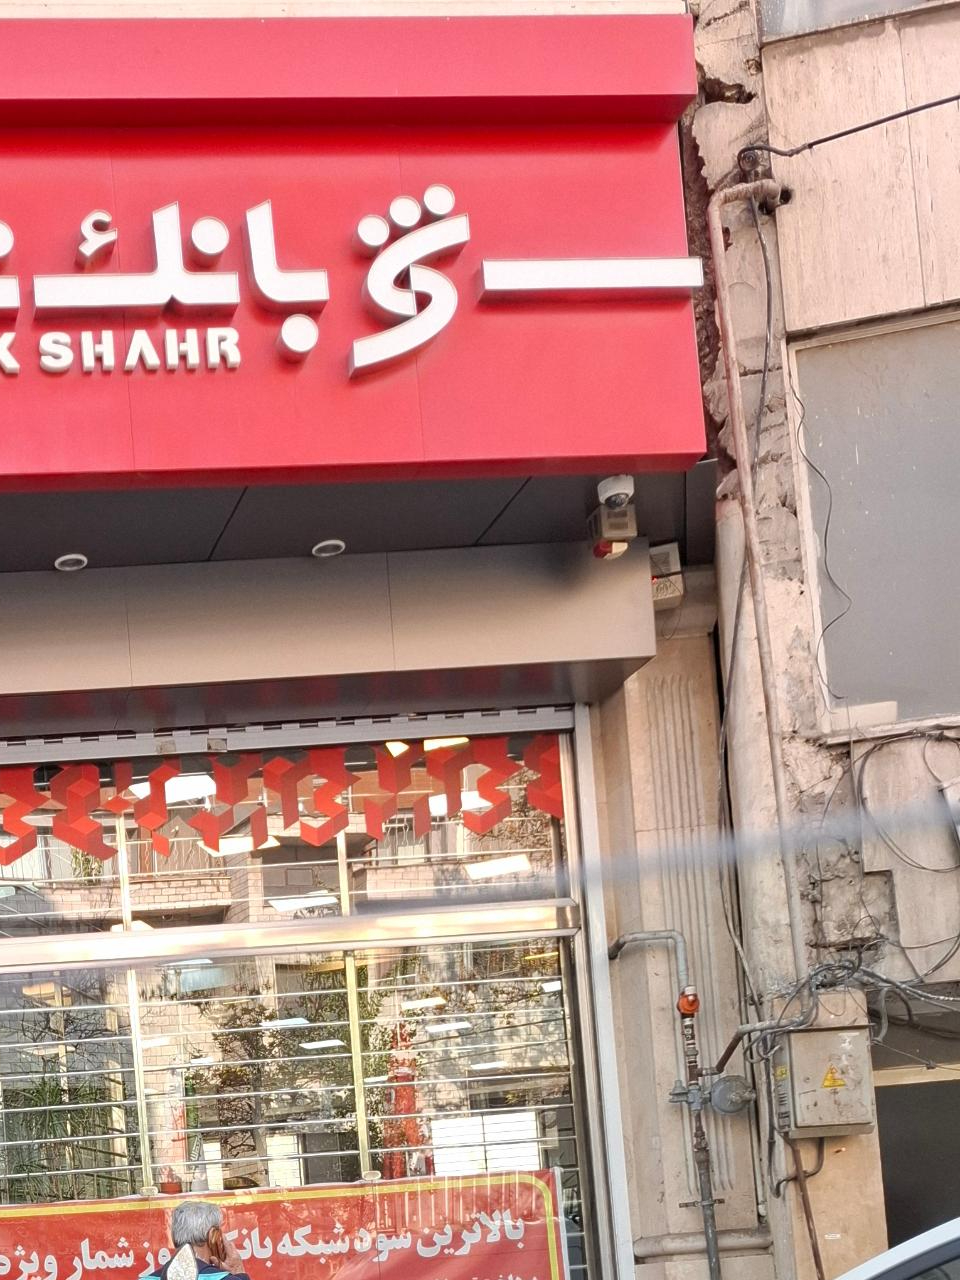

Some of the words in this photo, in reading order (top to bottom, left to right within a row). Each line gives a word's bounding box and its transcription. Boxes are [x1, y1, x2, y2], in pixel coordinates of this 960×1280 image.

[34, 199, 329, 363] بانک
[39, 326, 242, 375] SHAHR
[276, 1223, 350, 1264] شبکه
[354, 1226, 412, 1262] سود
[416, 1208, 525, 1259] بالاترین
[138, 1240, 172, 1278] وز
